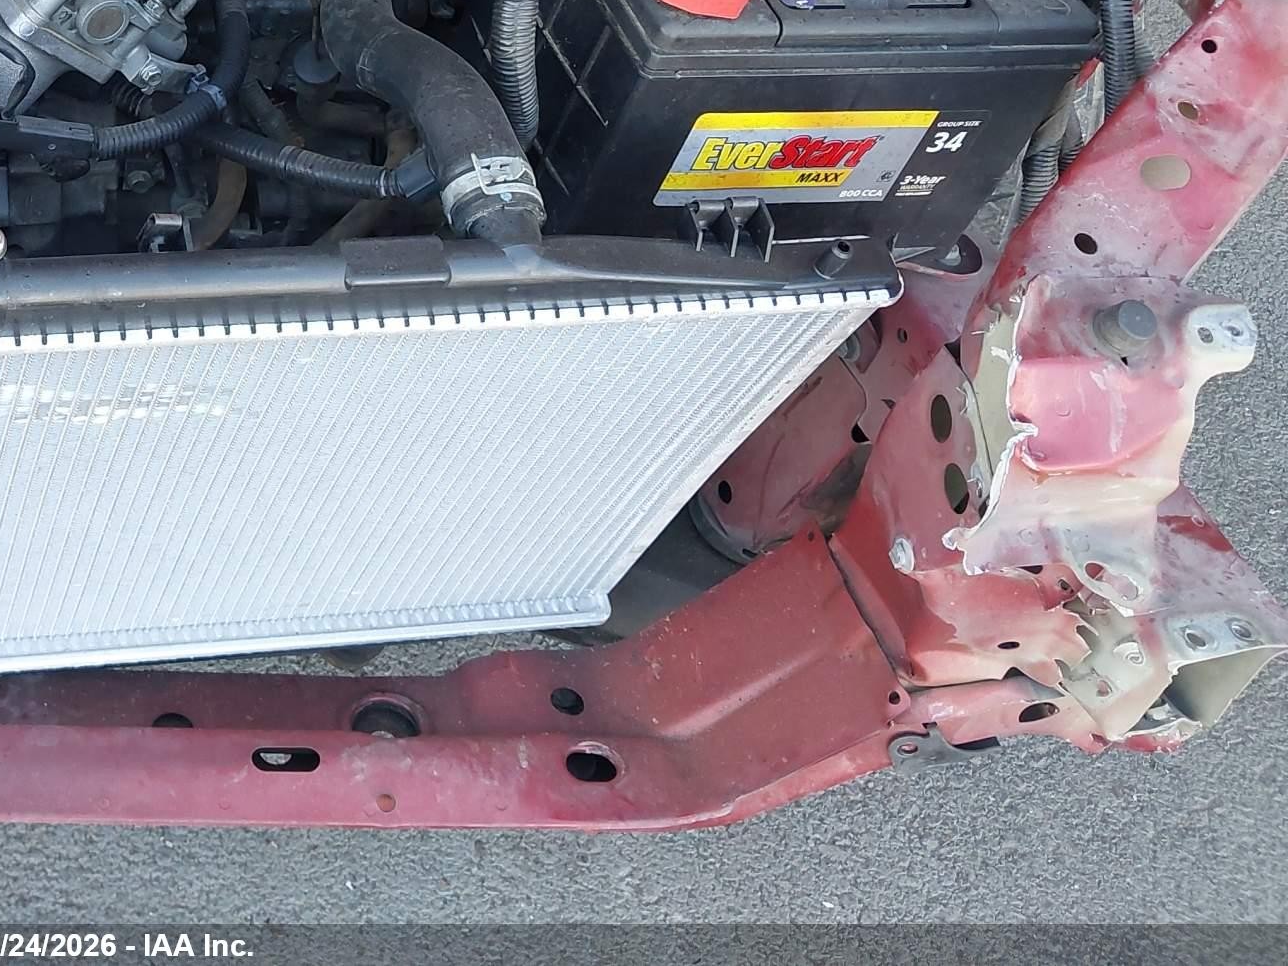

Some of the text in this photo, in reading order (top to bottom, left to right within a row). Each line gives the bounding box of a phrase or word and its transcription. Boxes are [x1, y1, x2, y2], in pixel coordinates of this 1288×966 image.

[925, 131, 969, 153] 34
[691, 134, 880, 171] EverStart
[795, 172, 845, 184] MAXX
[899, 175, 947, 185] 3-Year
[839, 189, 883, 198] 800 CCA
